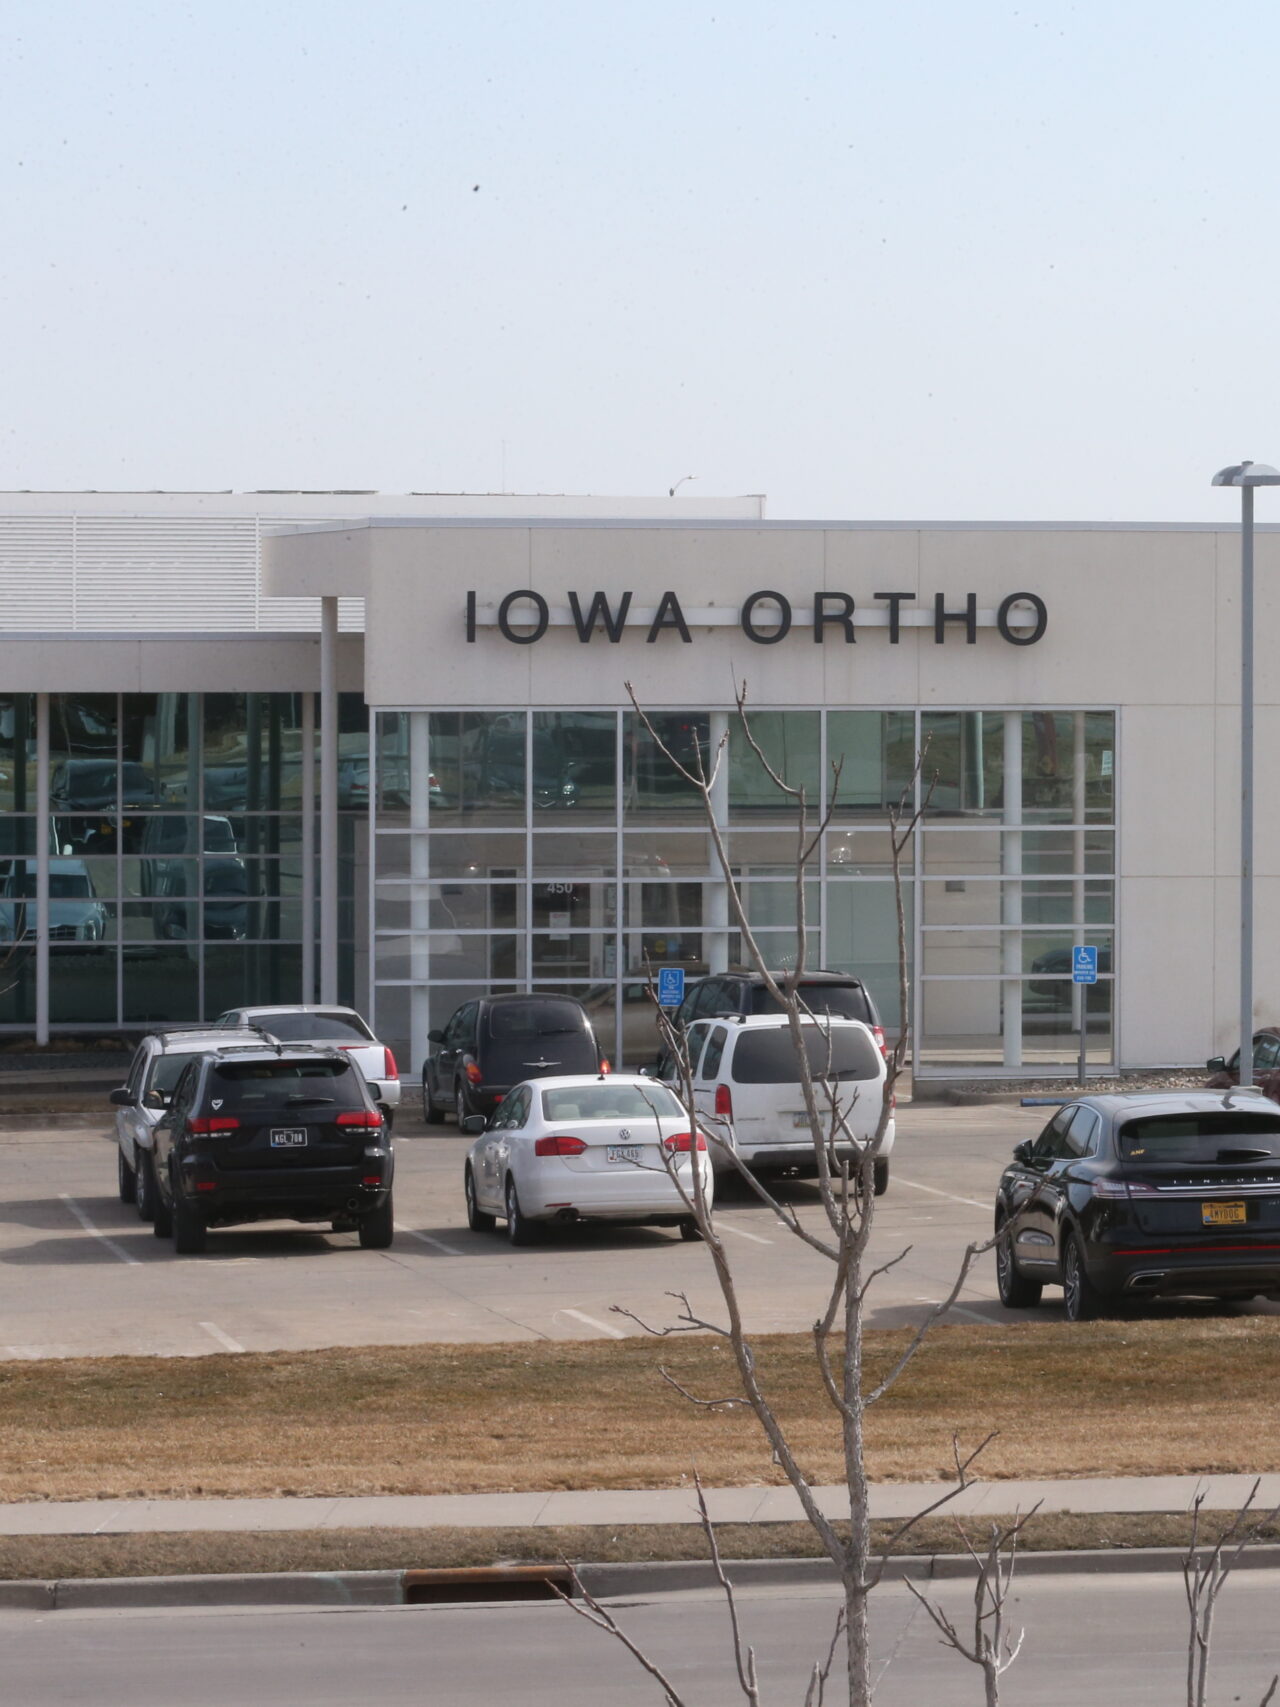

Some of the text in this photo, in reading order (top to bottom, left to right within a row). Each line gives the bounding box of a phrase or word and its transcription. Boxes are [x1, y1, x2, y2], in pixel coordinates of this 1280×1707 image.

[466, 590, 1048, 645] IOWA ORTHO
[547, 882, 573, 894] 450
